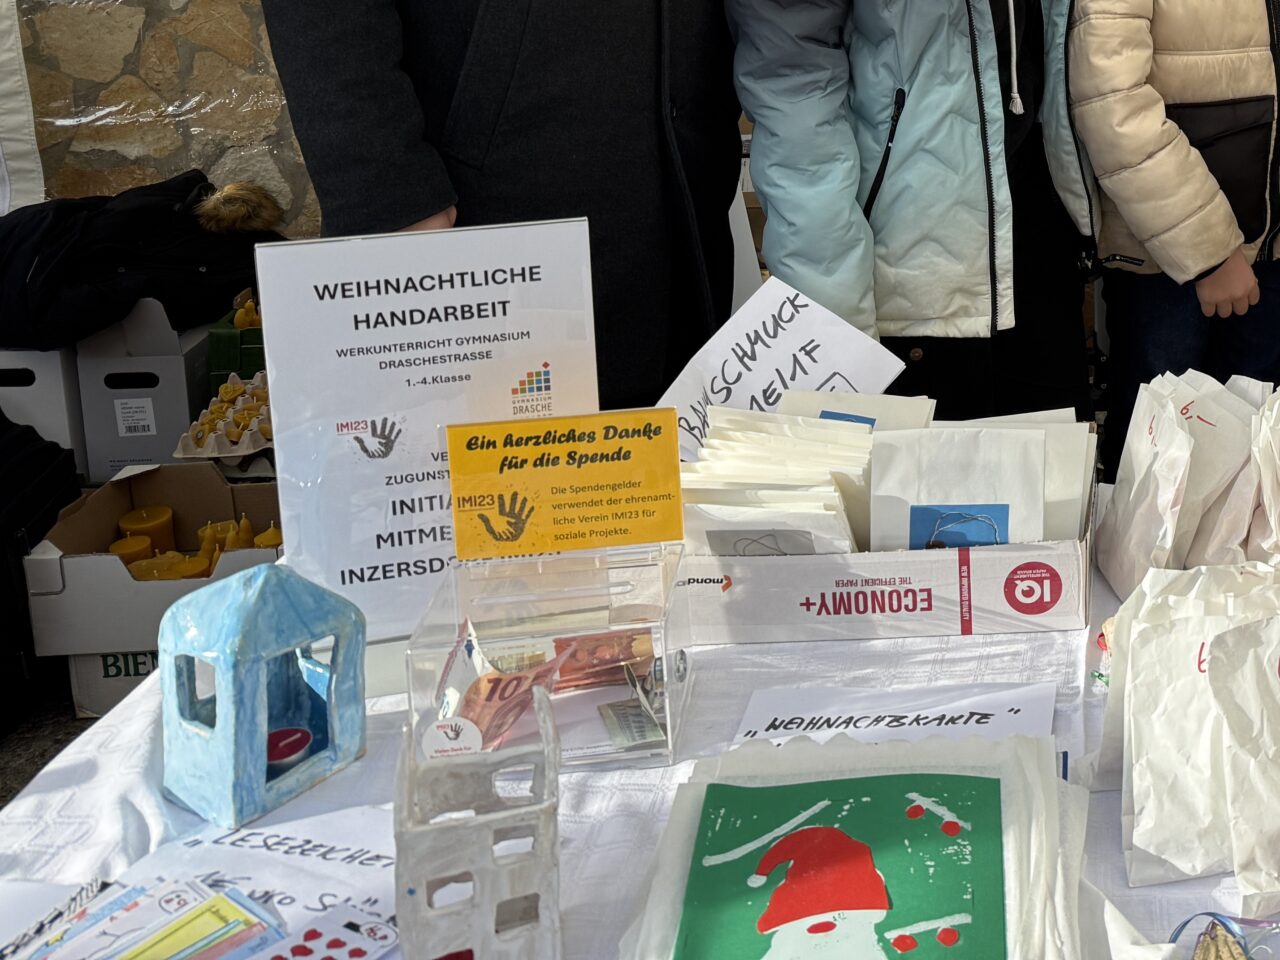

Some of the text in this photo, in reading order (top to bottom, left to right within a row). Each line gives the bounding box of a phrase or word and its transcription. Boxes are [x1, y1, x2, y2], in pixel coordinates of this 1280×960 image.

[313, 265, 542, 301] WEIHNACHTLICHE
[353, 300, 511, 331] HANDARBEIT
[335, 330, 531, 358] WERKUNTERRICHT GYMNASIUM
[378, 350, 493, 370] DRASCHESTRASSE
[512, 402, 553, 416] DRASCHE
[336, 420, 368, 433] IMI23
[466, 423, 662, 451] Ein herzliches Danke
[499, 447, 632, 474] für die Spende
[550, 480, 642, 496] Die Spendengelder
[391, 494, 453, 516] INITI
[457, 494, 496, 509] IMI23
[552, 492, 676, 511] verwendet der ehrenamt-
[553, 508, 656, 526] liche Verein IMI23 für
[376, 525, 453, 549] MITME
[553, 526, 632, 541] soziale Projekte.
[677, 577, 724, 587] mond
[835, 576, 912, 588] THE EFFICIENT PAPER
[1014, 579, 1051, 605] IQ
[799, 587, 934, 617] ECONOMY+
